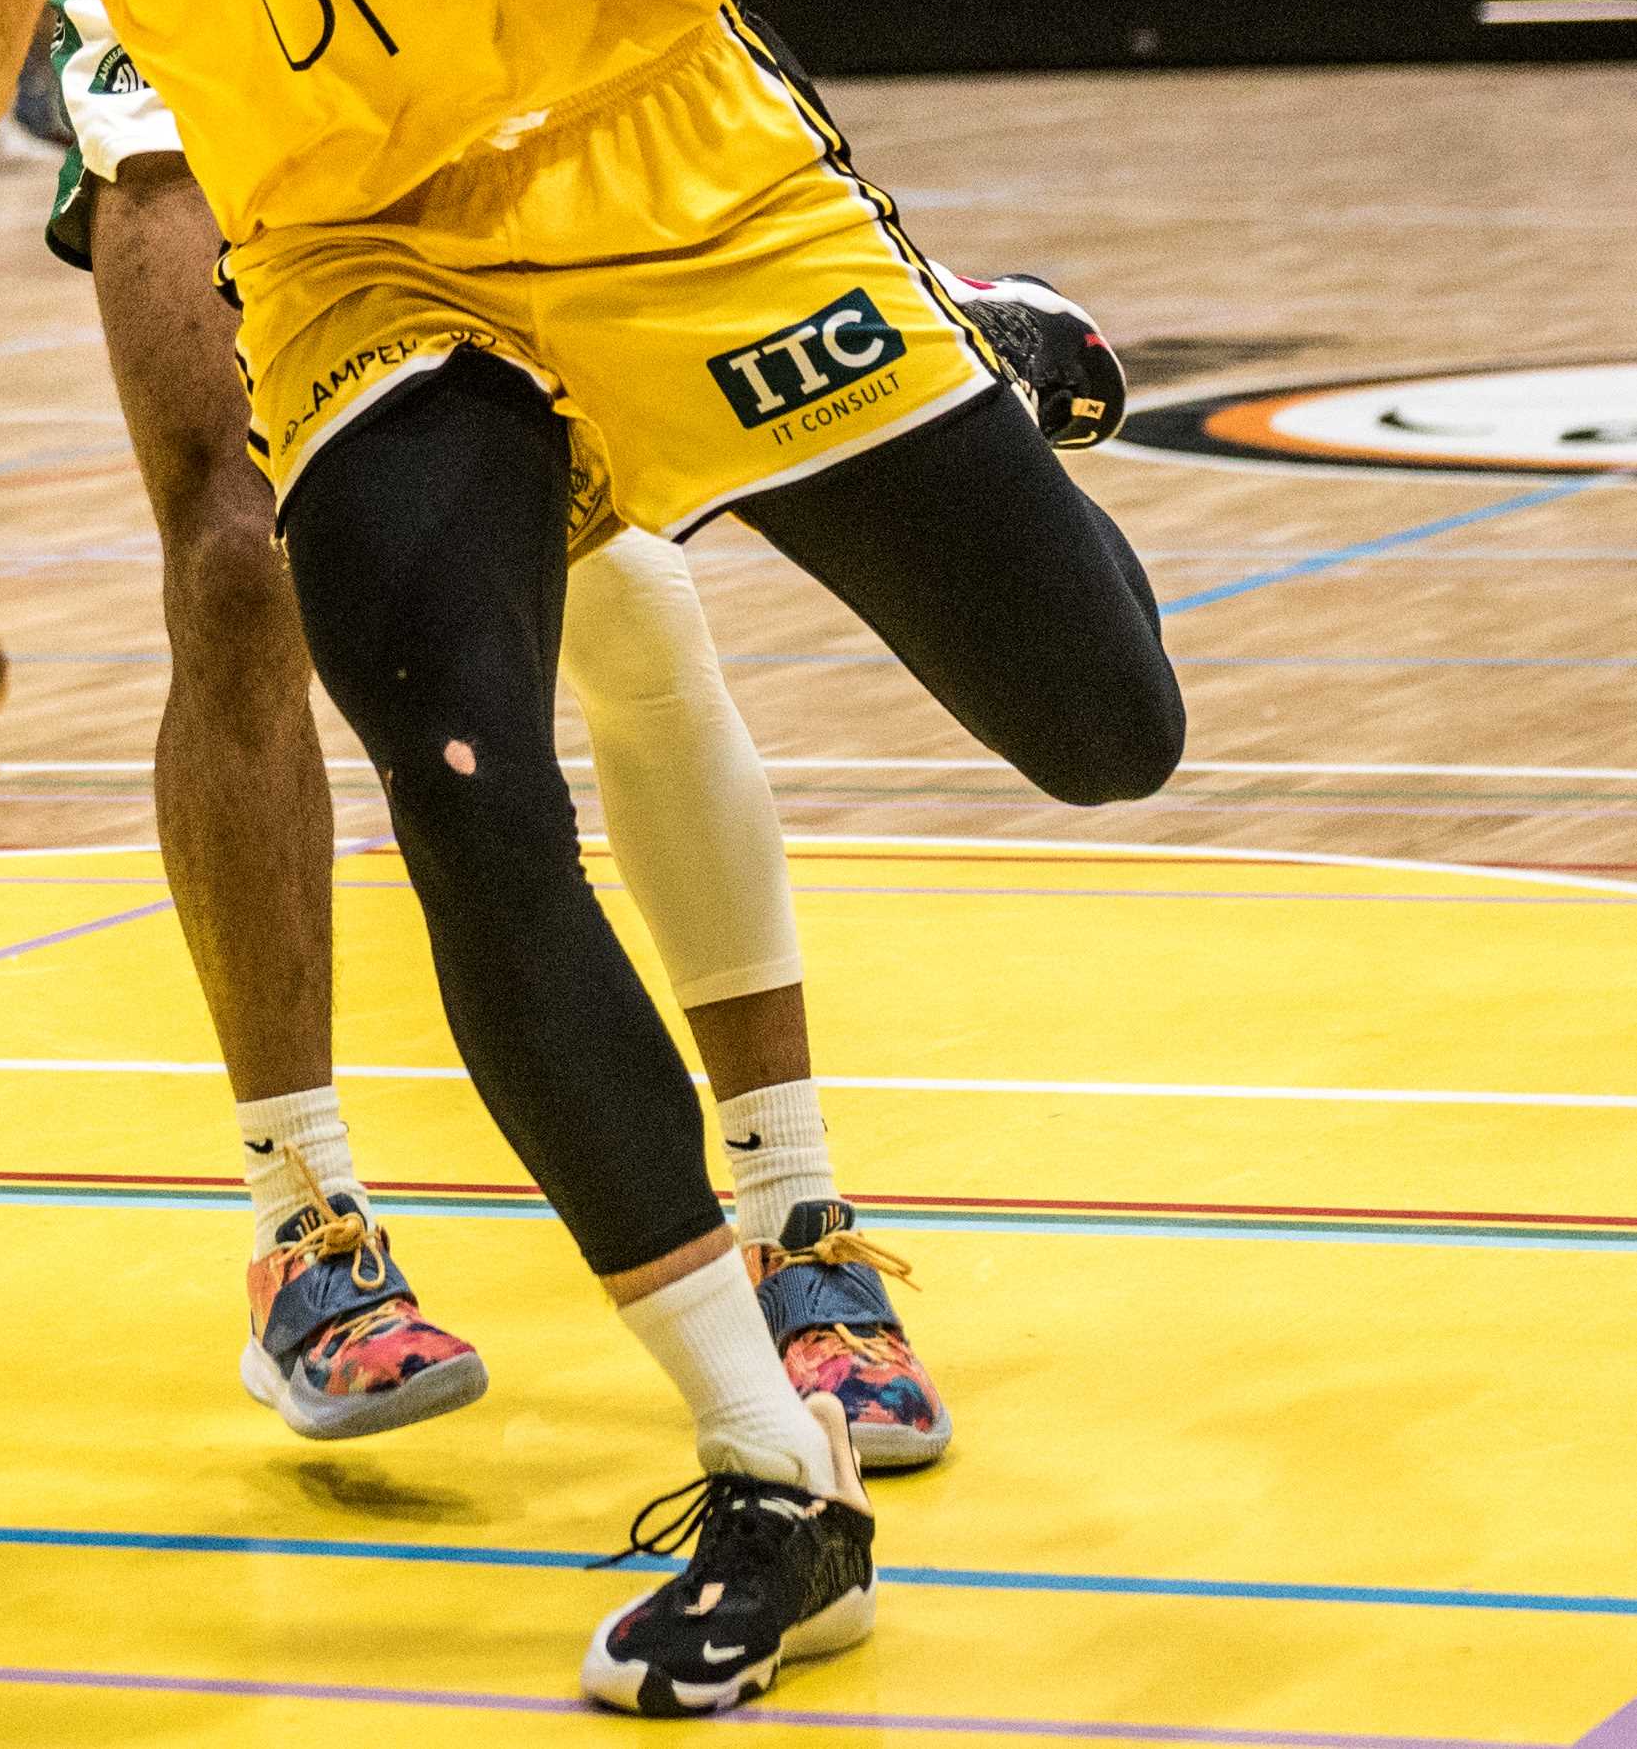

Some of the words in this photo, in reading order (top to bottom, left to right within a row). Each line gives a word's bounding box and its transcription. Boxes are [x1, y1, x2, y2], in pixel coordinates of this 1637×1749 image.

[728, 308, 885, 415] ITC
[771, 422, 794, 445] IT
[800, 371, 901, 432] CONSULT
